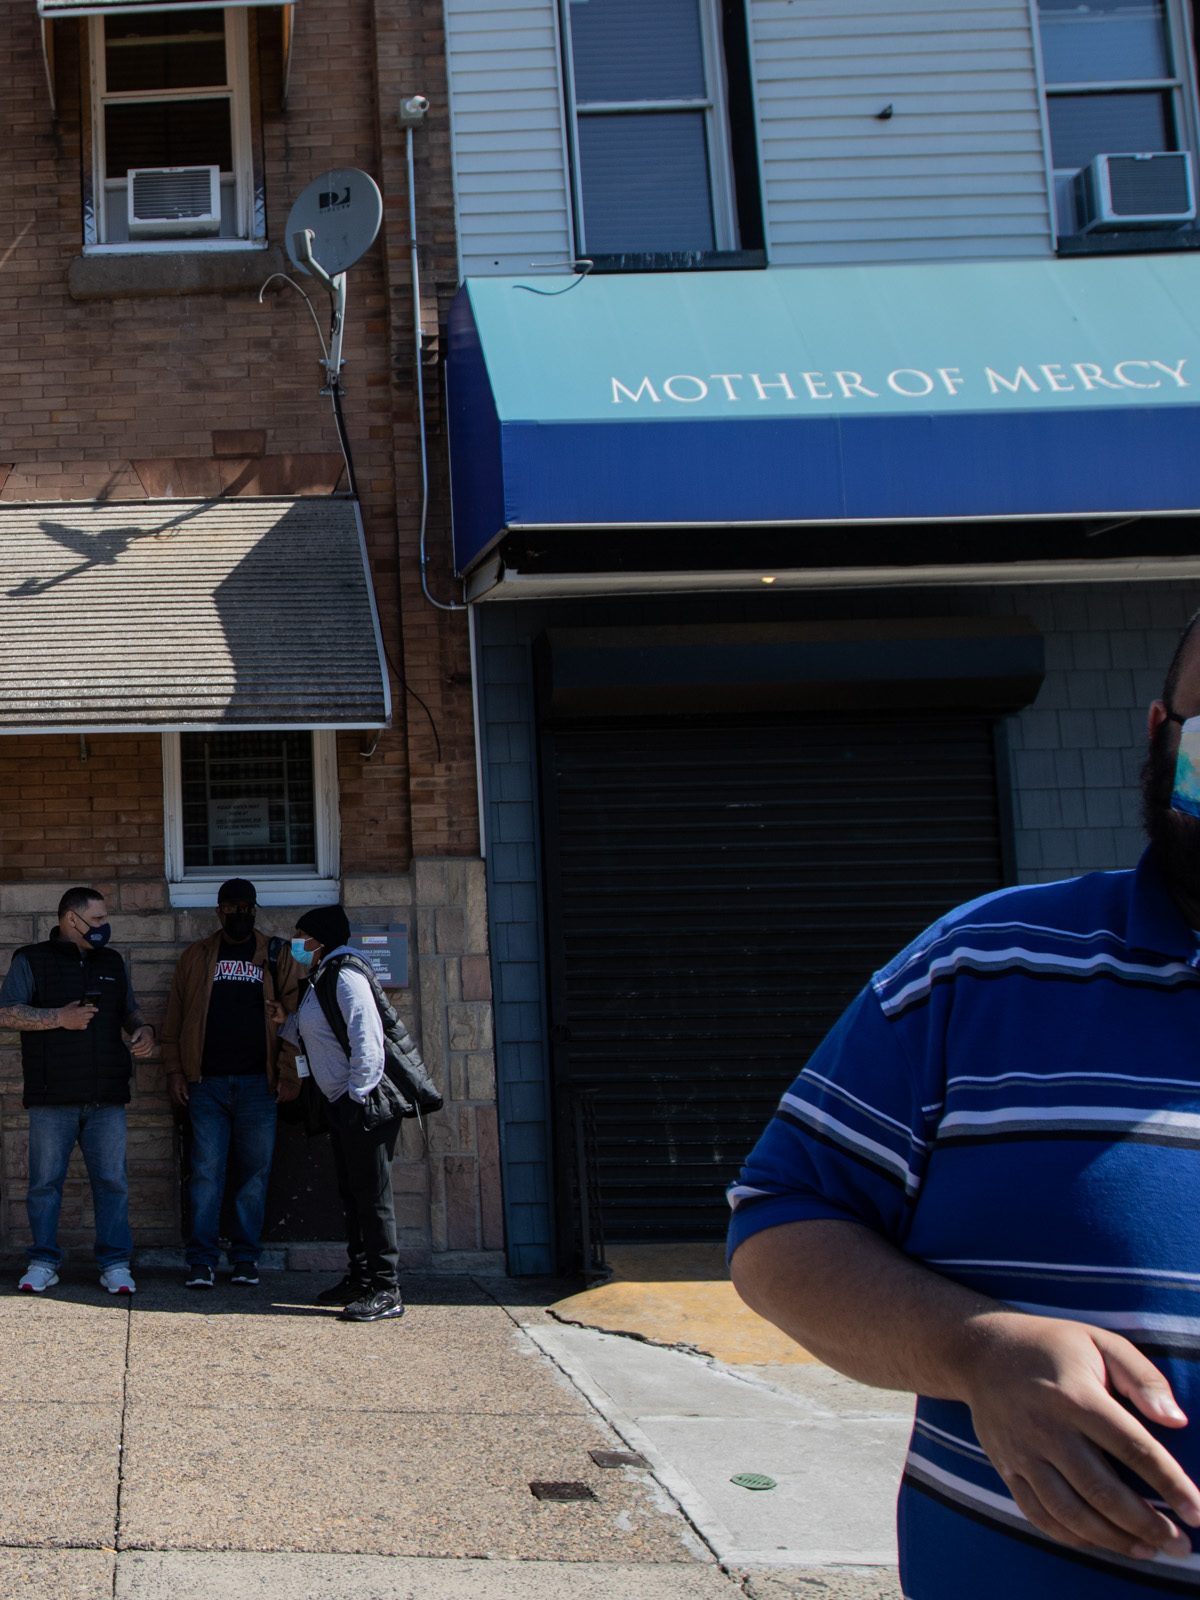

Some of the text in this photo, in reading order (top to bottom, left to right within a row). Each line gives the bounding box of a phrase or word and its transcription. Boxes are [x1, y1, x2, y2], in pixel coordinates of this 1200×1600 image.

[611, 359, 1191, 403] MOTHER OF MERCY
[214, 975, 255, 983] NIVERSITY
